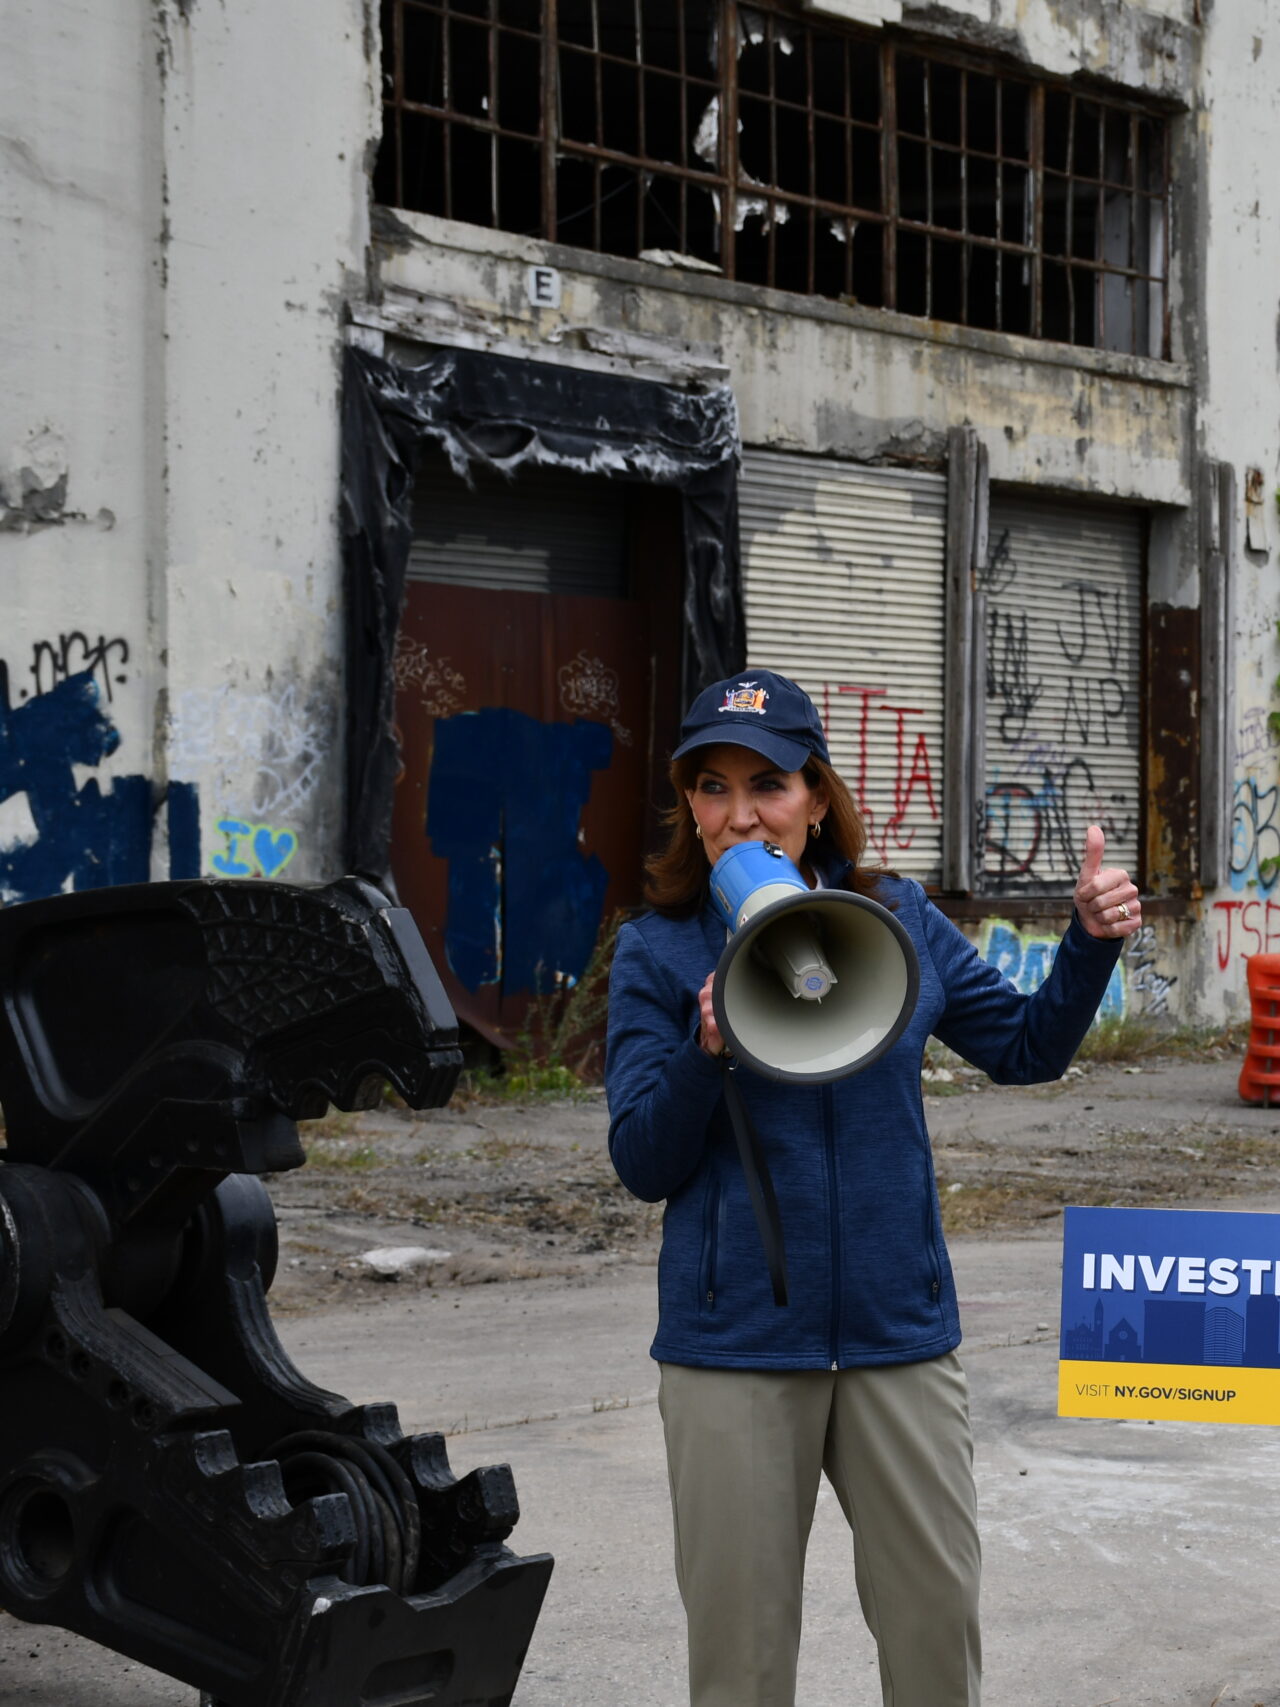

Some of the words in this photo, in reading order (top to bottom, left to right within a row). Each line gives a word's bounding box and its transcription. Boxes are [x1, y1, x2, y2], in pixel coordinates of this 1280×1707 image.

[535, 270, 553, 301] E
[1075, 1383, 1110, 1397] VISIT
[1114, 1385, 1237, 1402] NY.GOV/SIGNUP
